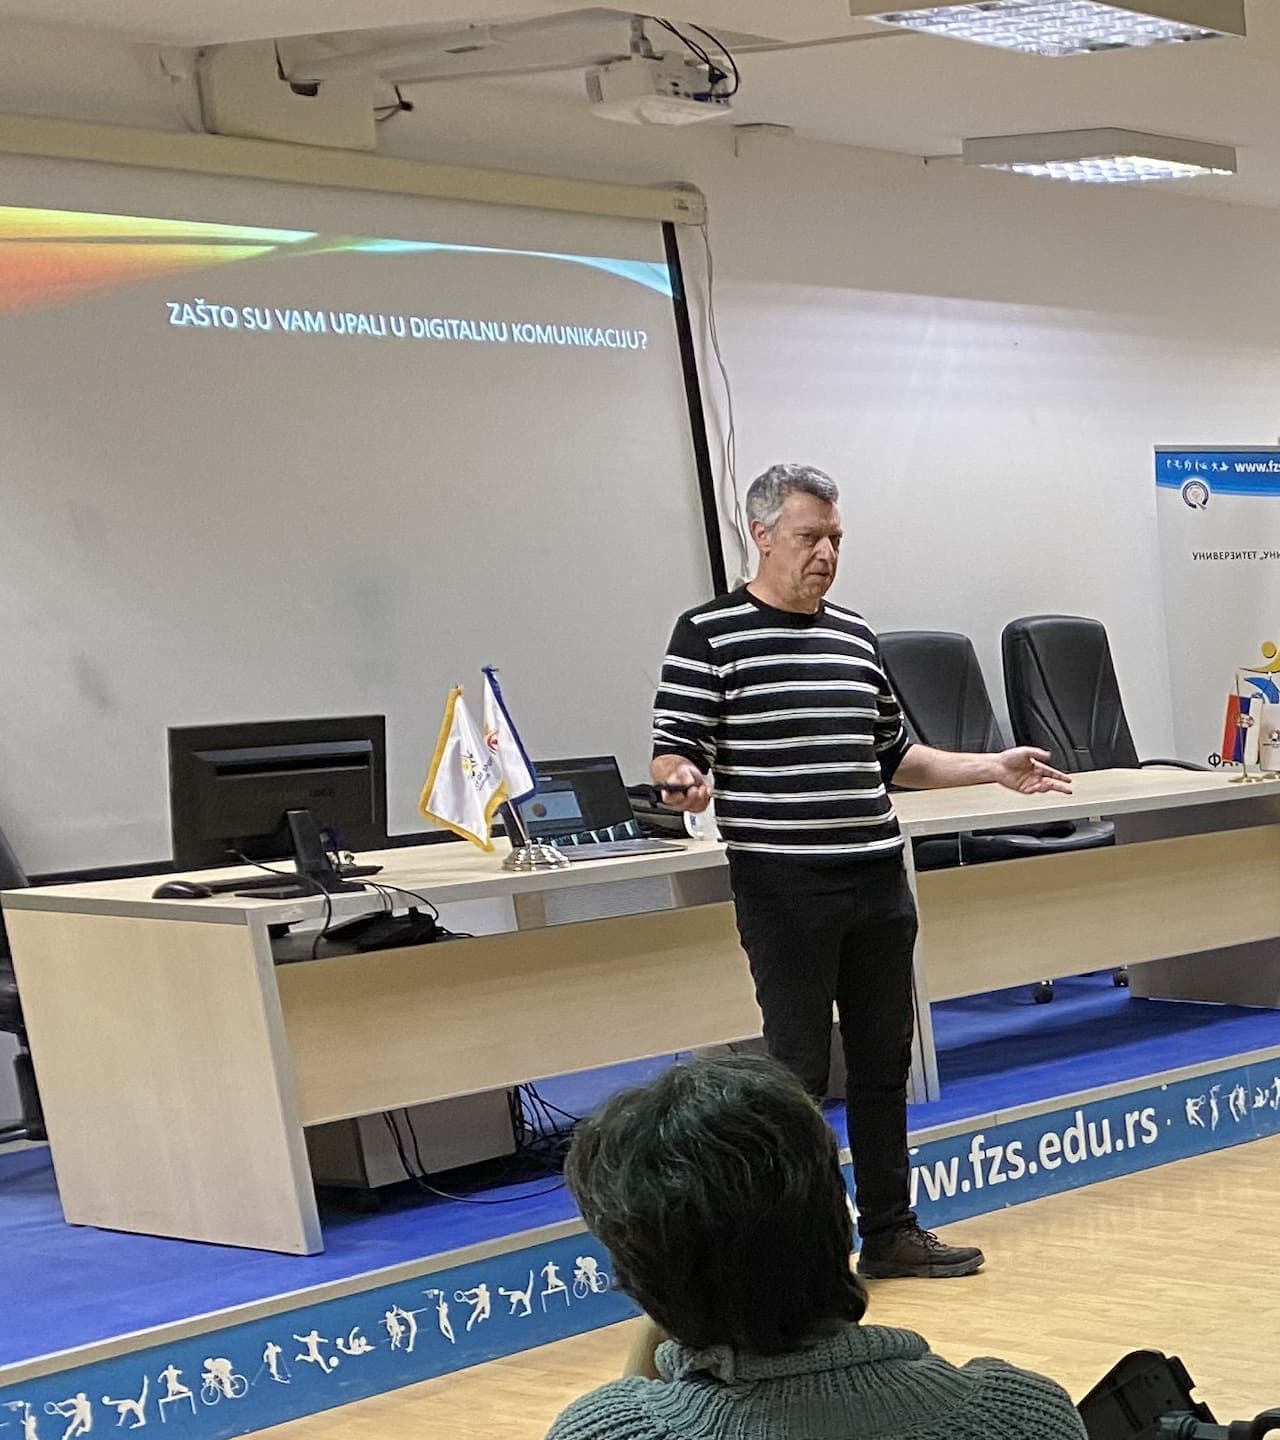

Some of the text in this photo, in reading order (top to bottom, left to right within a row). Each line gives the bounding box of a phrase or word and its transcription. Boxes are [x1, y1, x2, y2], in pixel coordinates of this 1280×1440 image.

[166, 298, 648, 350] ZAŠTO SU VAM UPALI U DIGITALNU KOMUNIKACIJU?
[1192, 551, 1257, 561] УНИВЕРЗИТЕТ
[908, 1107, 1158, 1208] w.fzs.edu.rs
